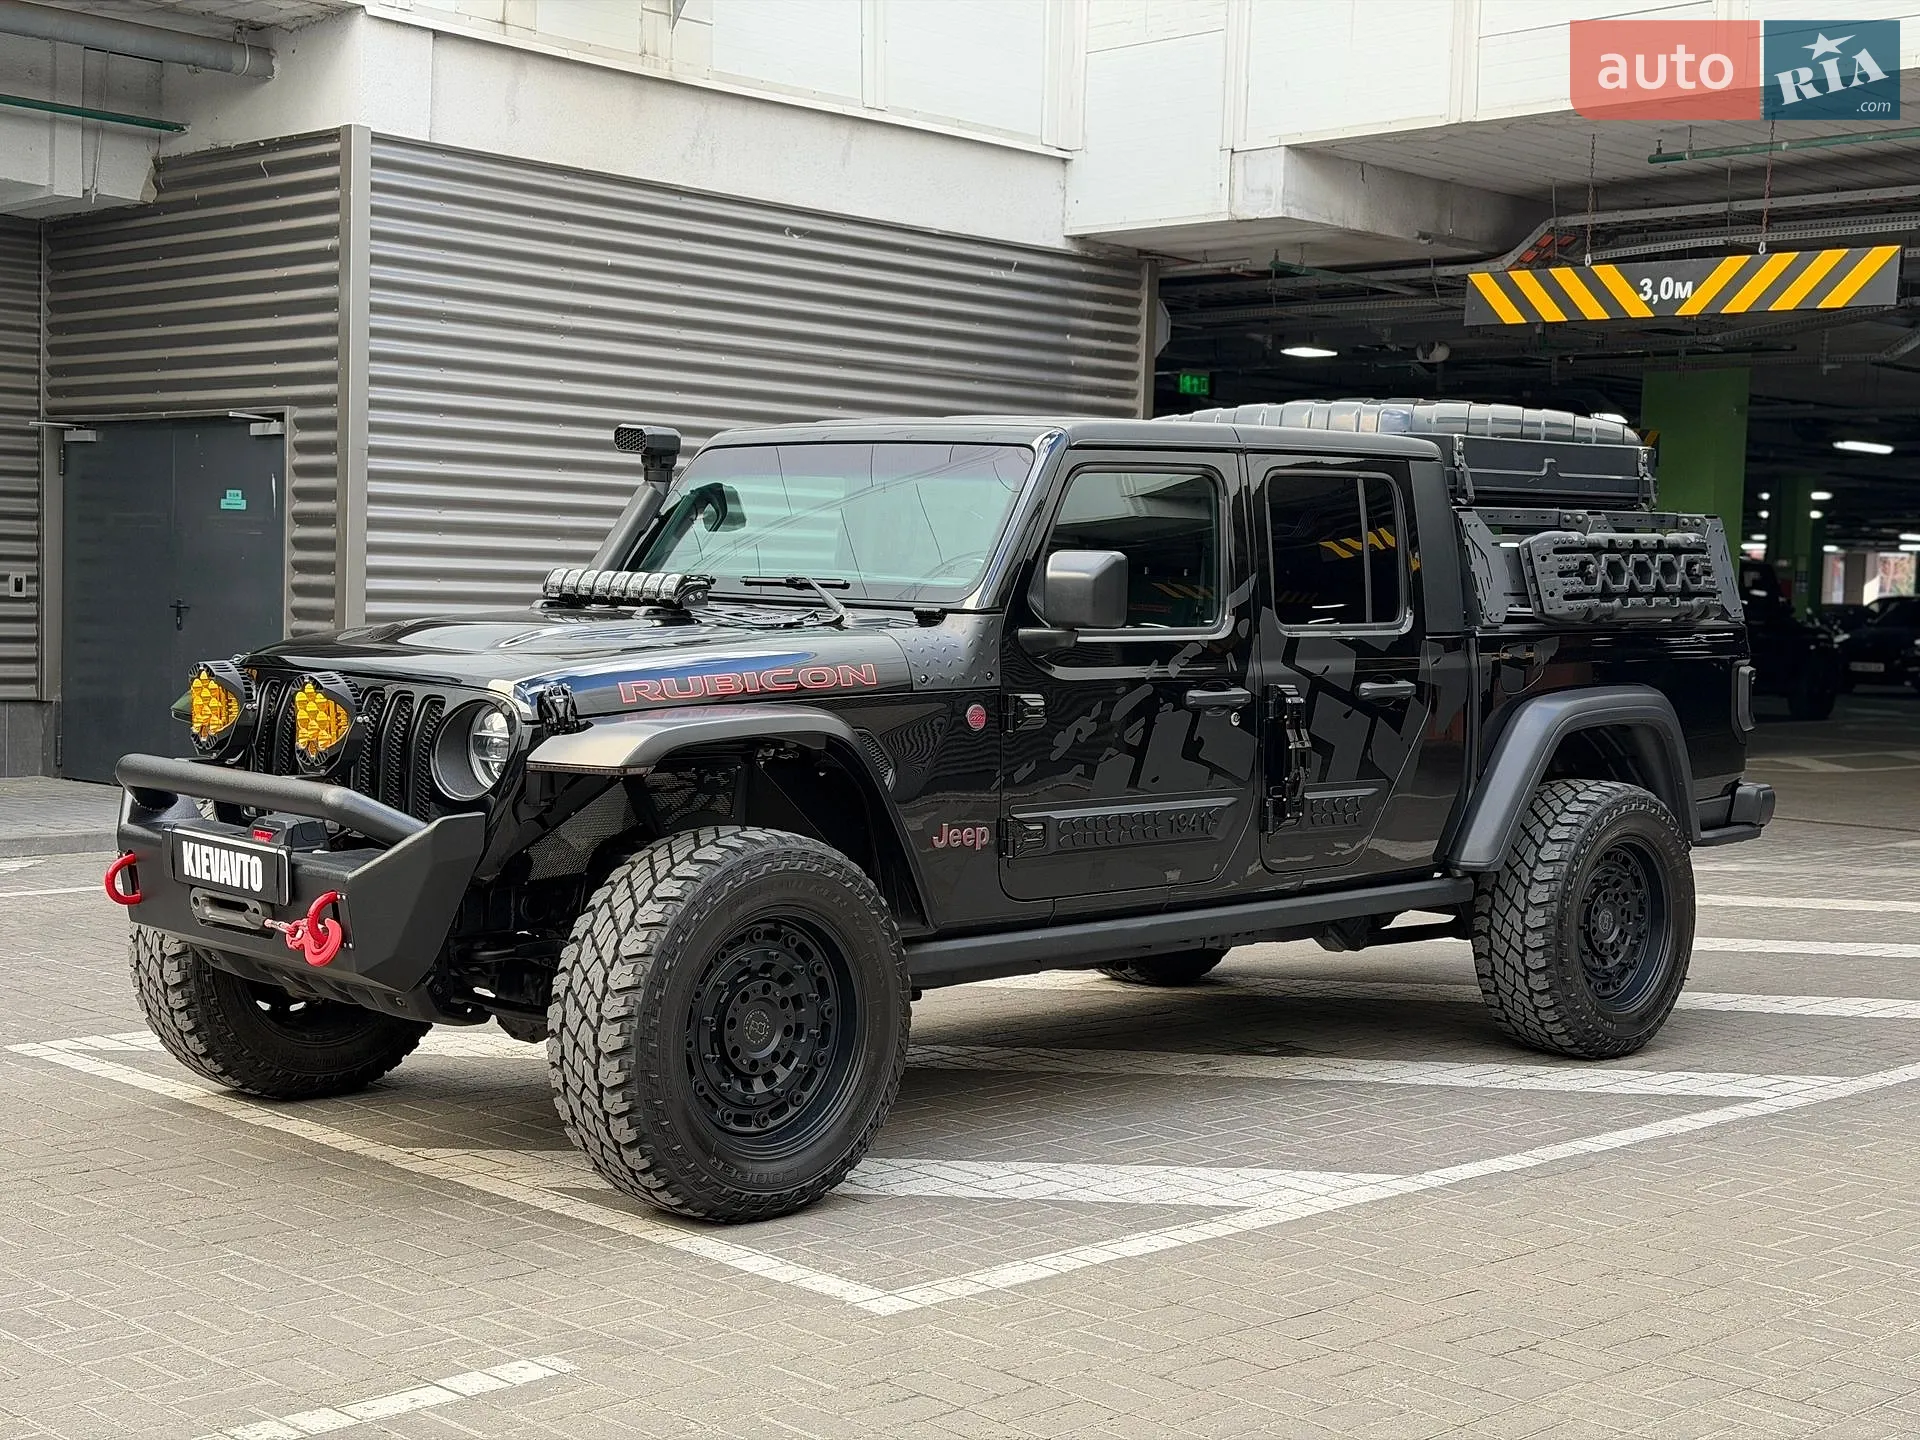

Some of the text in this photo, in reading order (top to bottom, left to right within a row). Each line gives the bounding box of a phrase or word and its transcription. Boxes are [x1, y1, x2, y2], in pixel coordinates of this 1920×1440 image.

[617, 663, 878, 704] RUBICON
[932, 823, 990, 851] Jeep
[182, 840, 263, 893] KIEVAVTO
